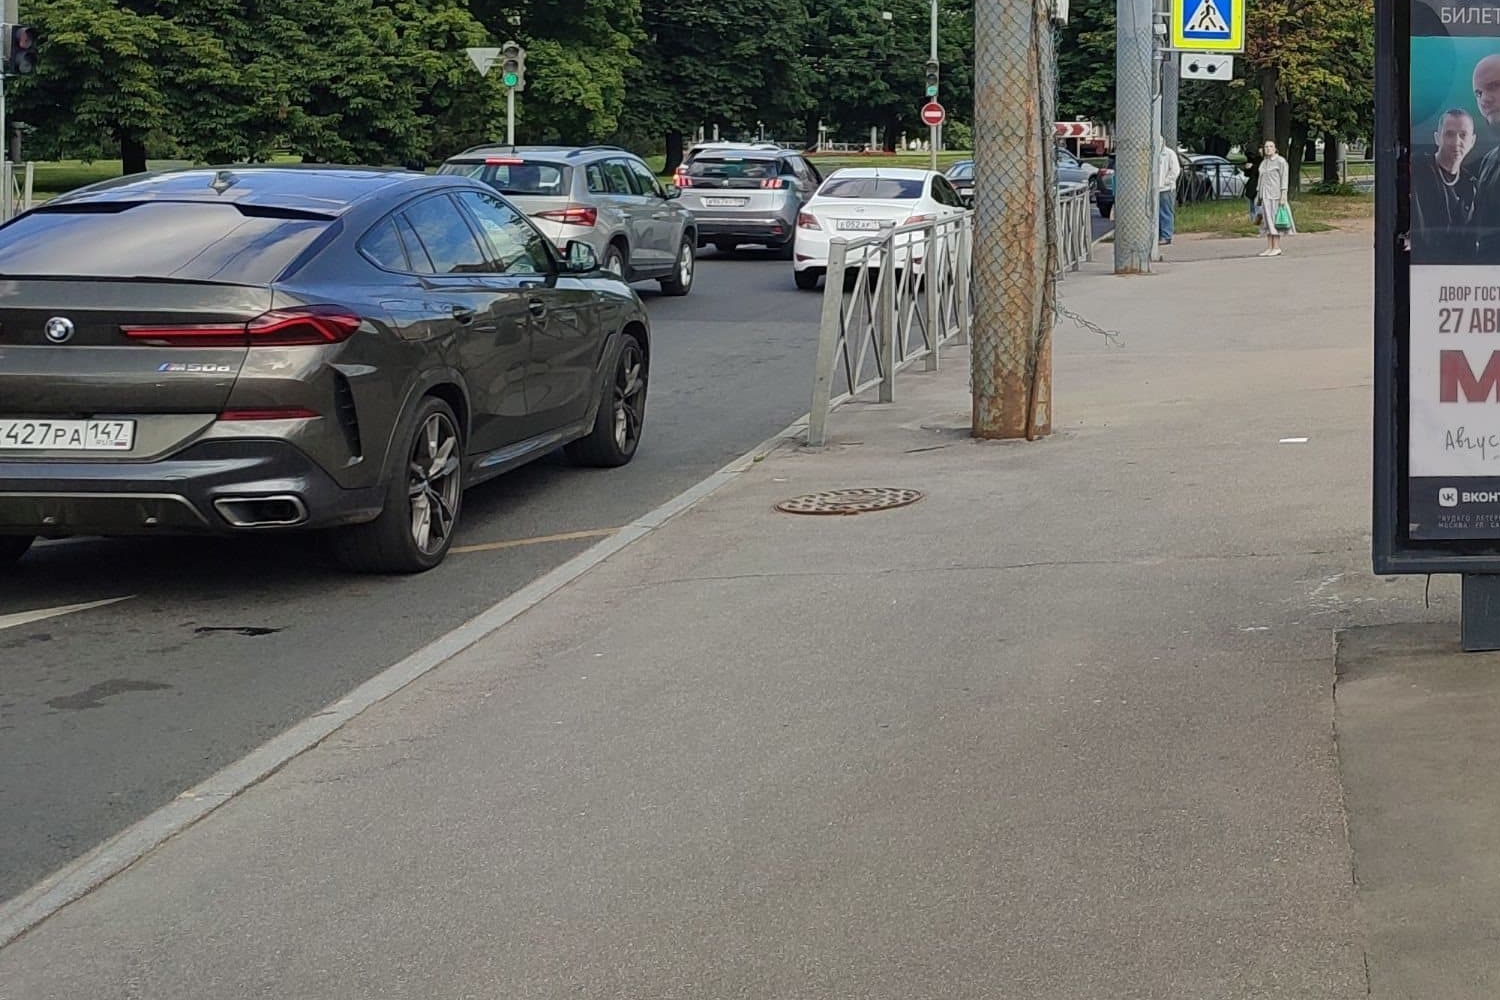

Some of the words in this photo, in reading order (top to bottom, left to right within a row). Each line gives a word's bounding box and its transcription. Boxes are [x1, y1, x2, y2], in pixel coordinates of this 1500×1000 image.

[1438, 286, 1472, 303] ДВОР
[1438, 307, 1465, 334] 27
[0, 422, 82, 445] 427РА
[89, 422, 124, 440] 147
